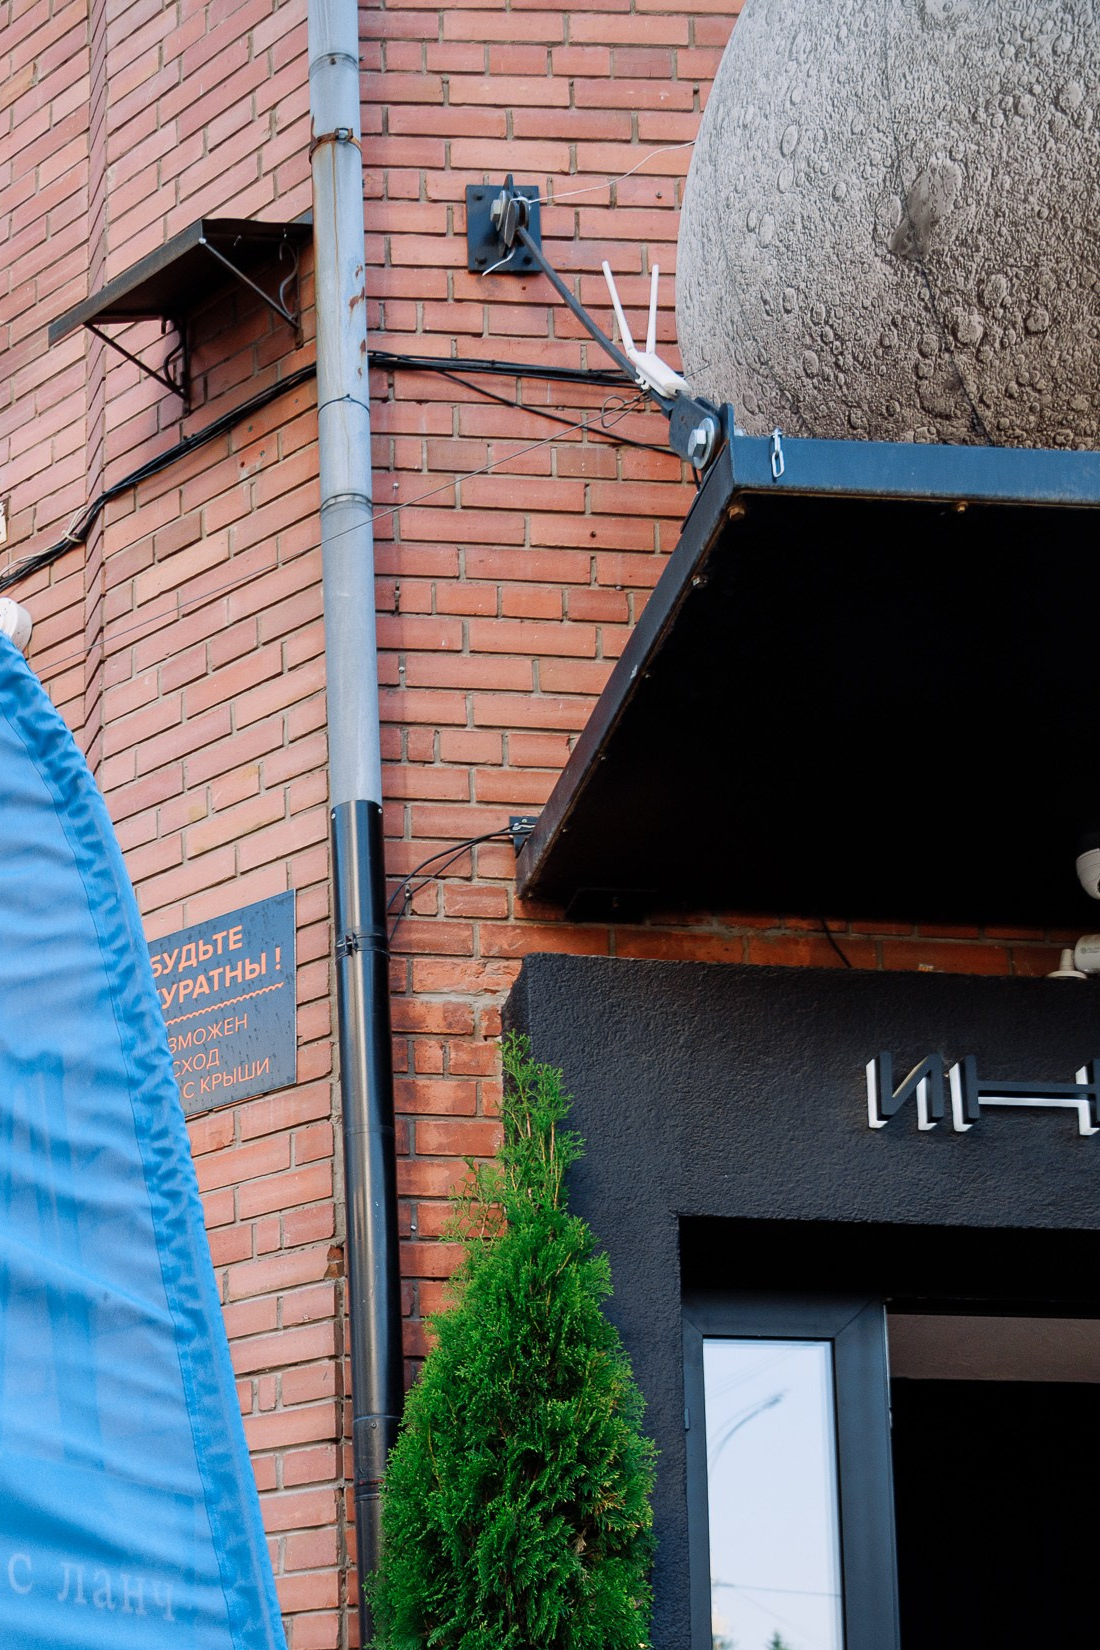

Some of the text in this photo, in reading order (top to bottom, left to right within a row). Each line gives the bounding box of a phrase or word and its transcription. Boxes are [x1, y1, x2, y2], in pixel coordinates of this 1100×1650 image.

[149, 925, 243, 978] БУДЬТЕ
[156, 952, 266, 1010] УРАТНЫ
[169, 1013, 248, 1054] ЗМОЖЕН
[182, 1057, 270, 1099] С КРЫШИ
